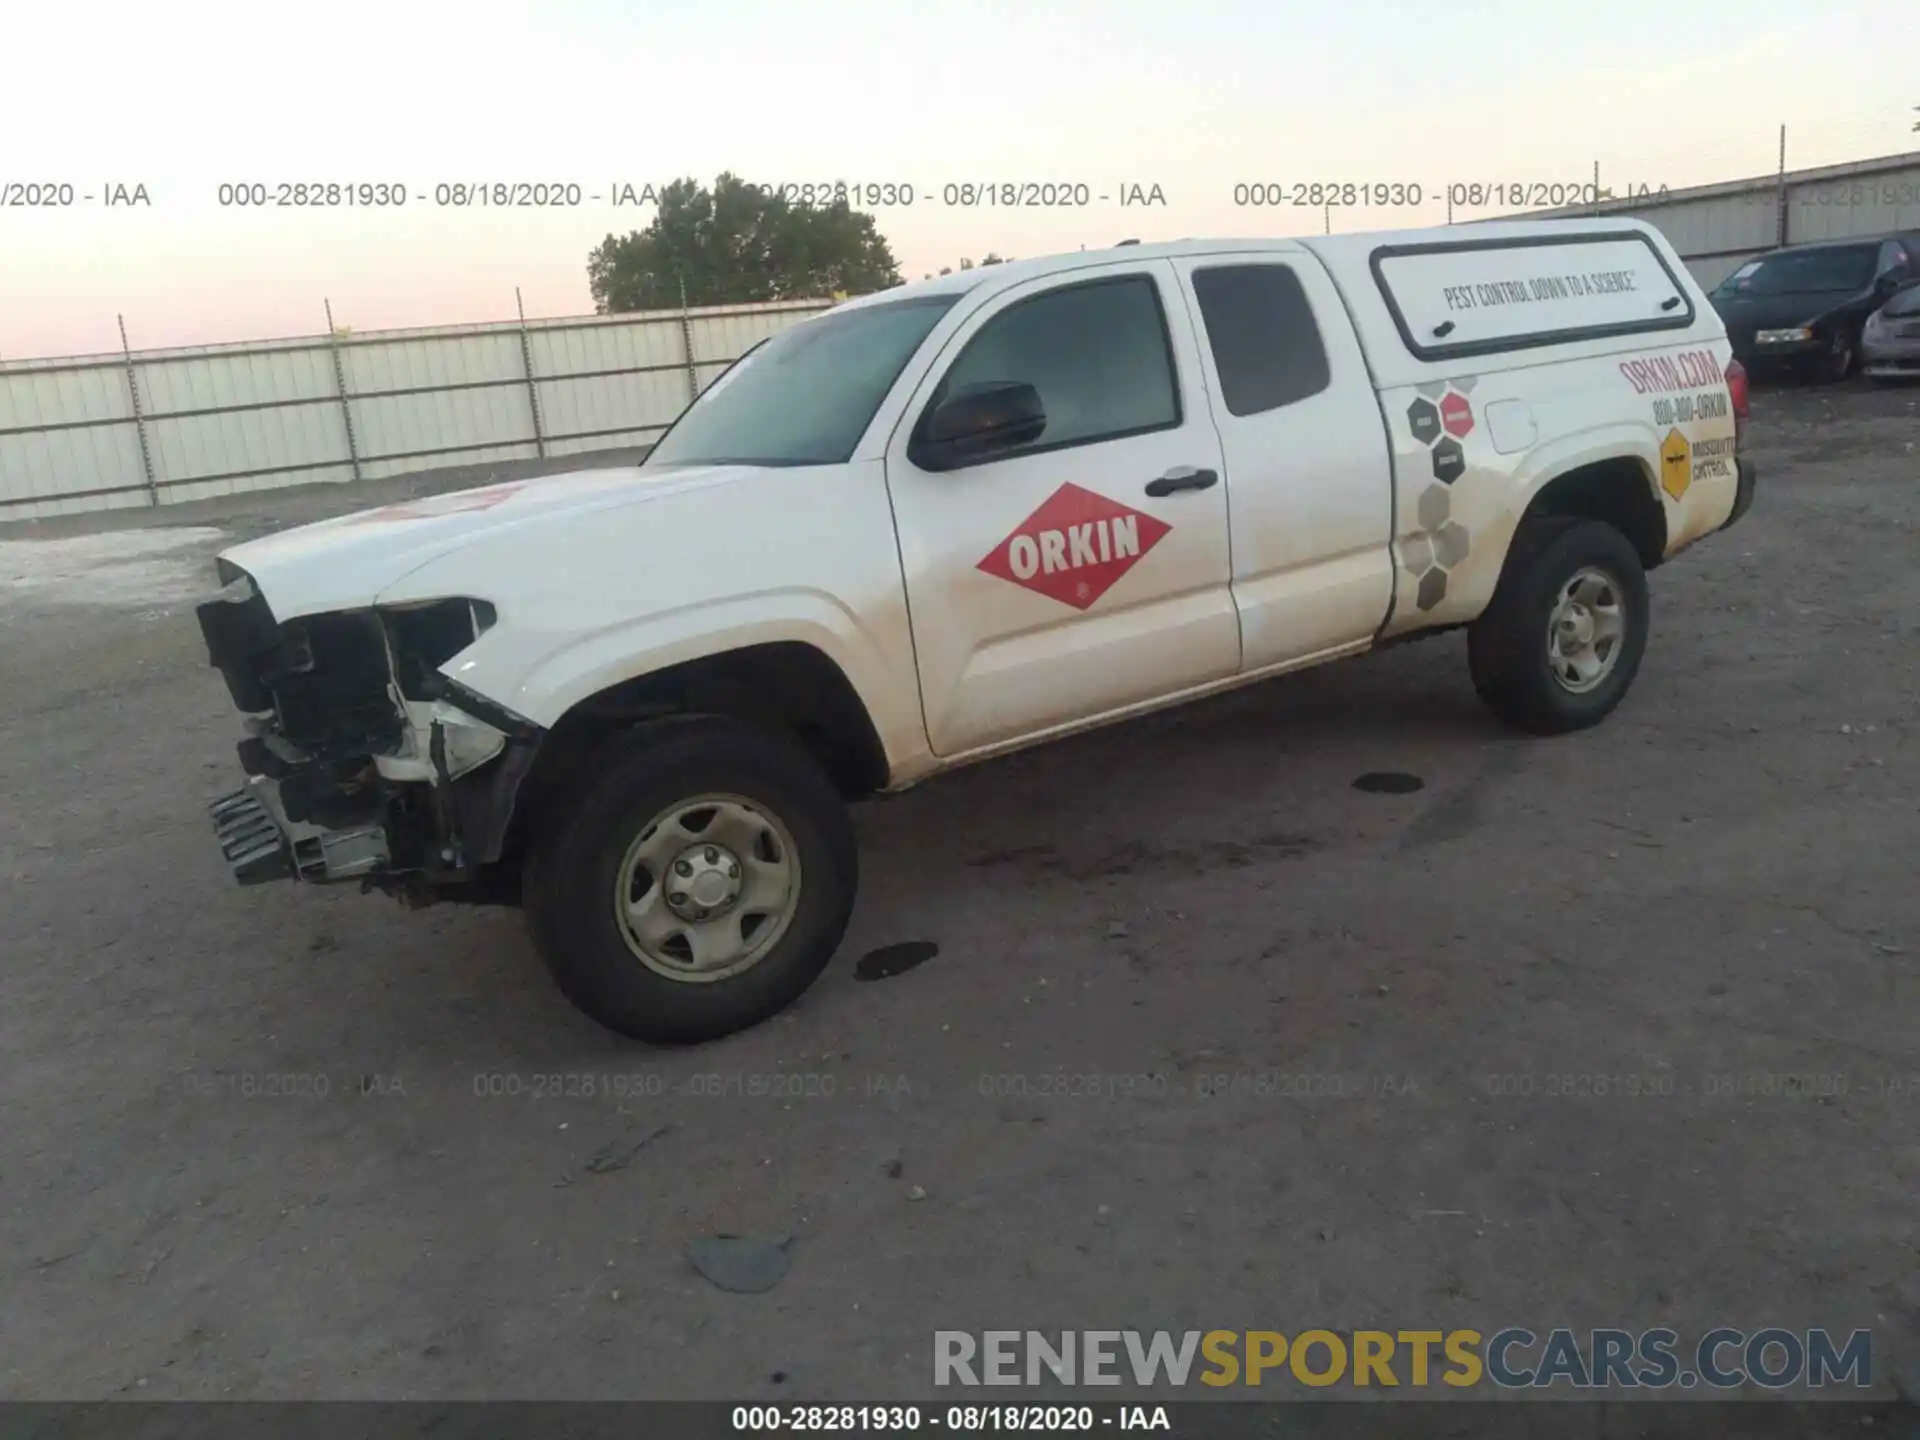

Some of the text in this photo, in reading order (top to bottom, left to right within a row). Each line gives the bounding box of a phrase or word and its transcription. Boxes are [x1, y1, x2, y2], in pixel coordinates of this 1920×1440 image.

[1443, 285, 1477, 310] PEST
[1476, 280, 1532, 307] CONTROL
[1529, 276, 1568, 301] DOWN
[1565, 274, 1584, 297] TO
[1582, 274, 1594, 295] A
[1618, 350, 1723, 394] ORKIN.COM
[1009, 515, 1140, 580] ORKIN
